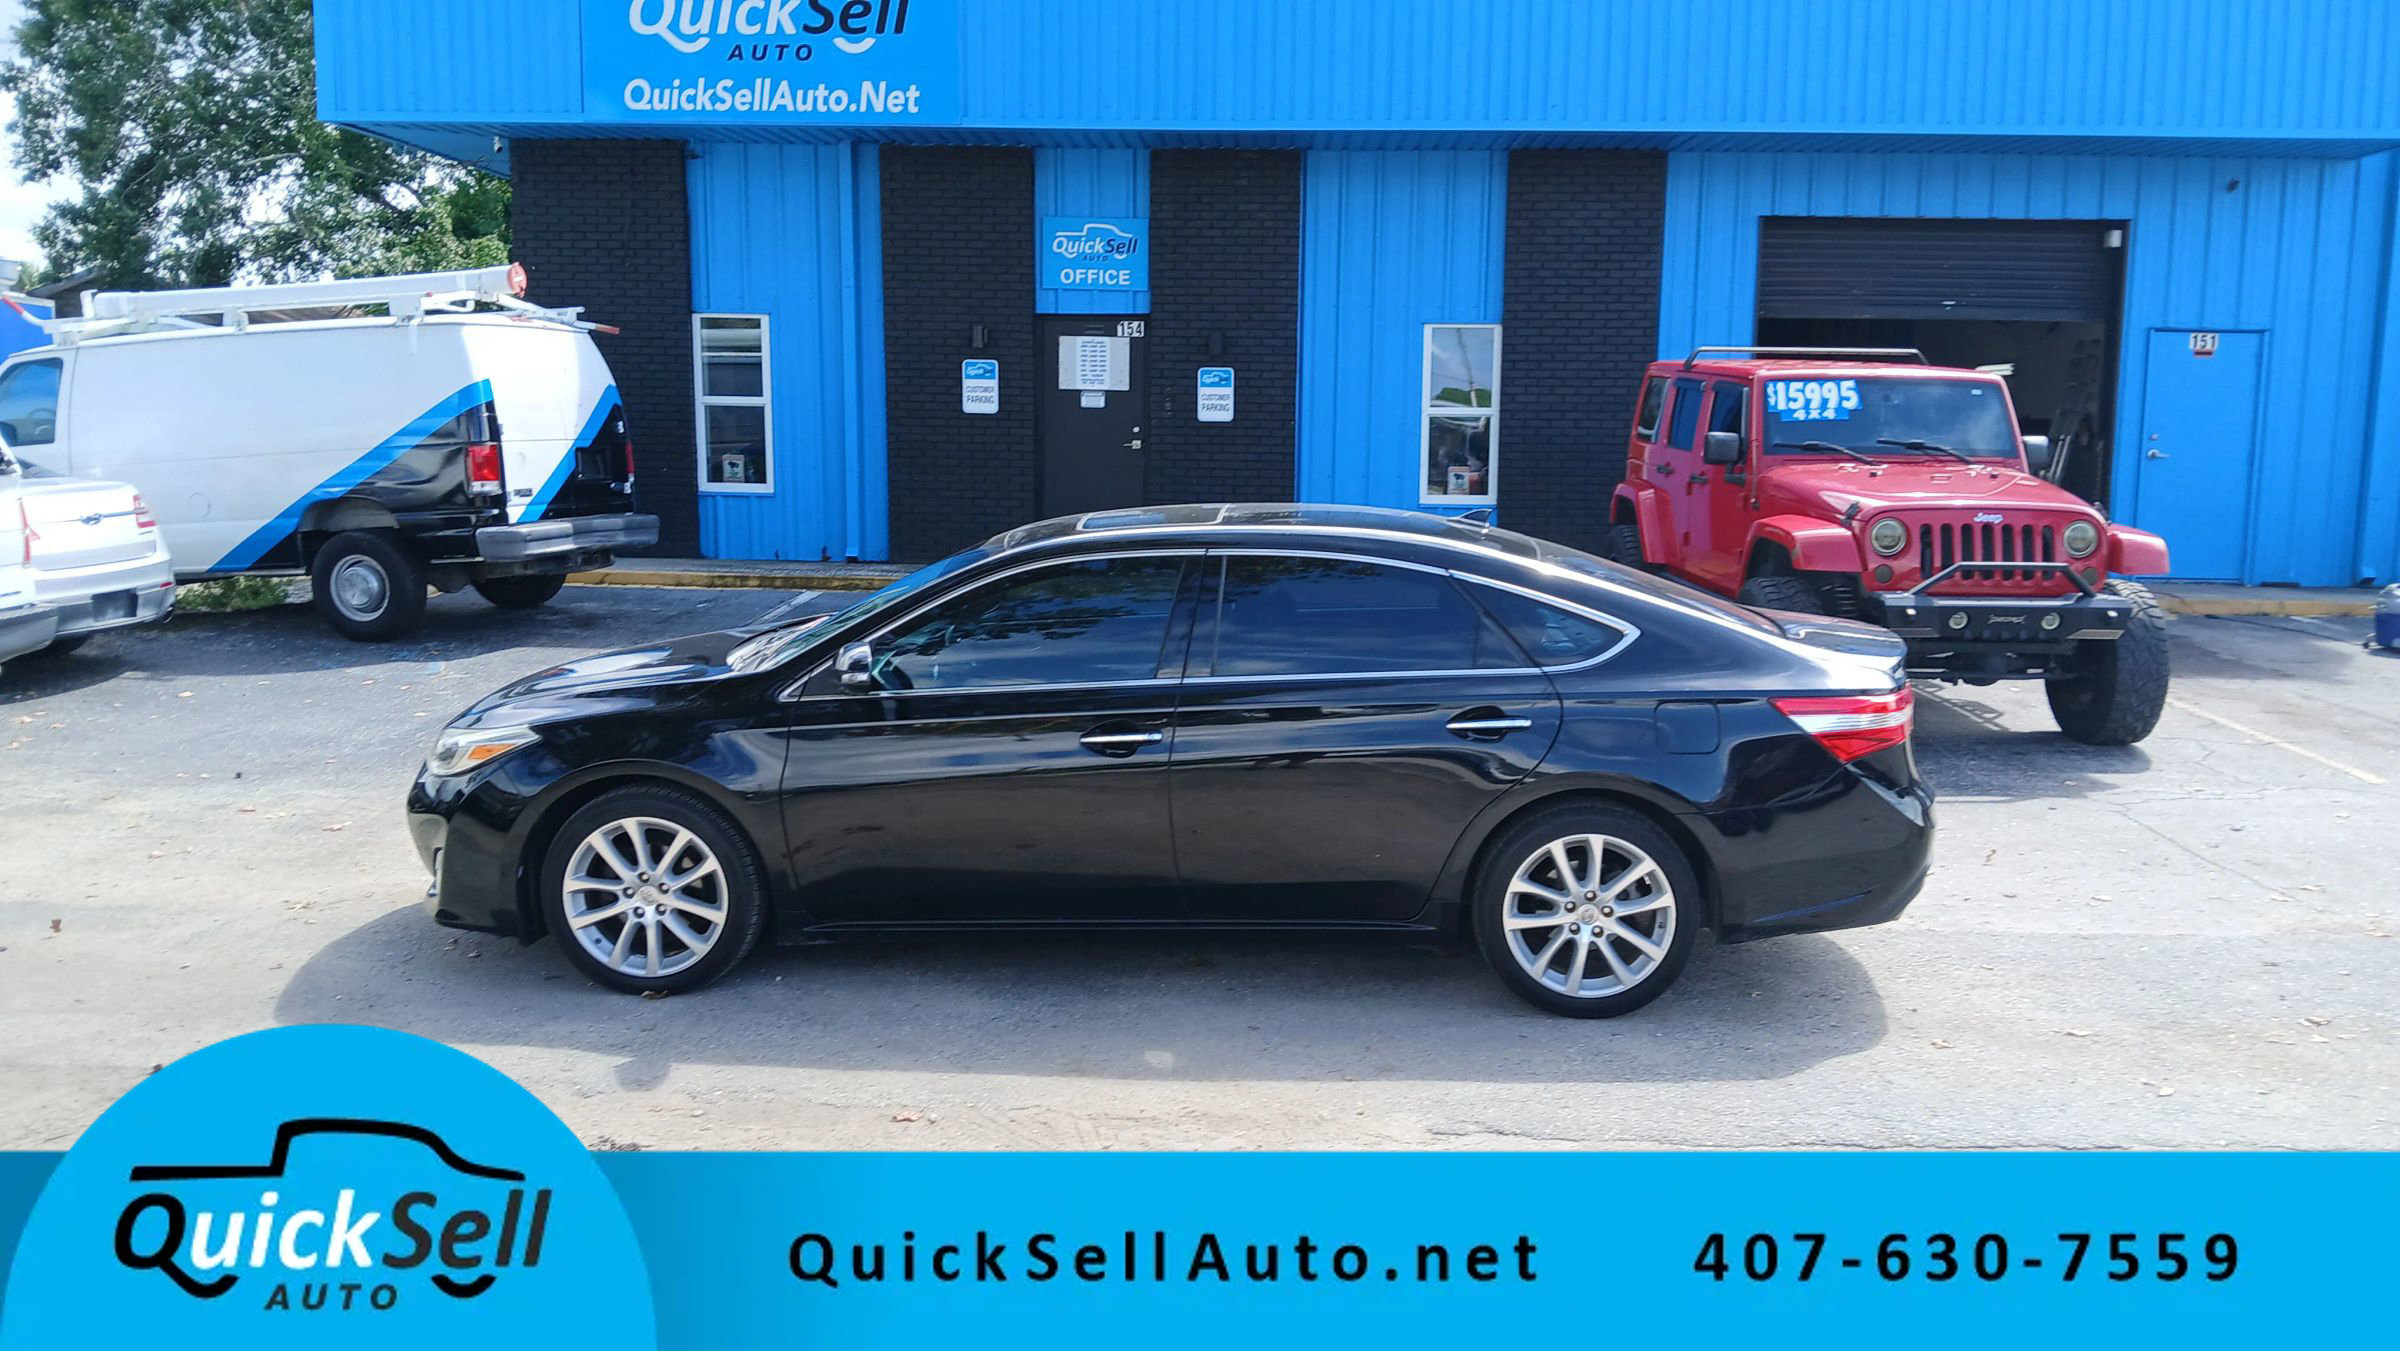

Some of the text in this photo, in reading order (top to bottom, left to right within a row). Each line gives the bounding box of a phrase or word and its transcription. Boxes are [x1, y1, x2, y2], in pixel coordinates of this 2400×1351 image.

[628, 0, 909, 54] QuickSell
[727, 43, 813, 61] AUTO
[623, 77, 921, 113] QuickSellAuto.Net
[1052, 236, 1138, 259] QuickSell
[1060, 268, 1131, 285] OFFICE
[1119, 322, 1143, 336] 154
[2192, 334, 2216, 349] 151
[1766, 380, 1860, 410] $15995
